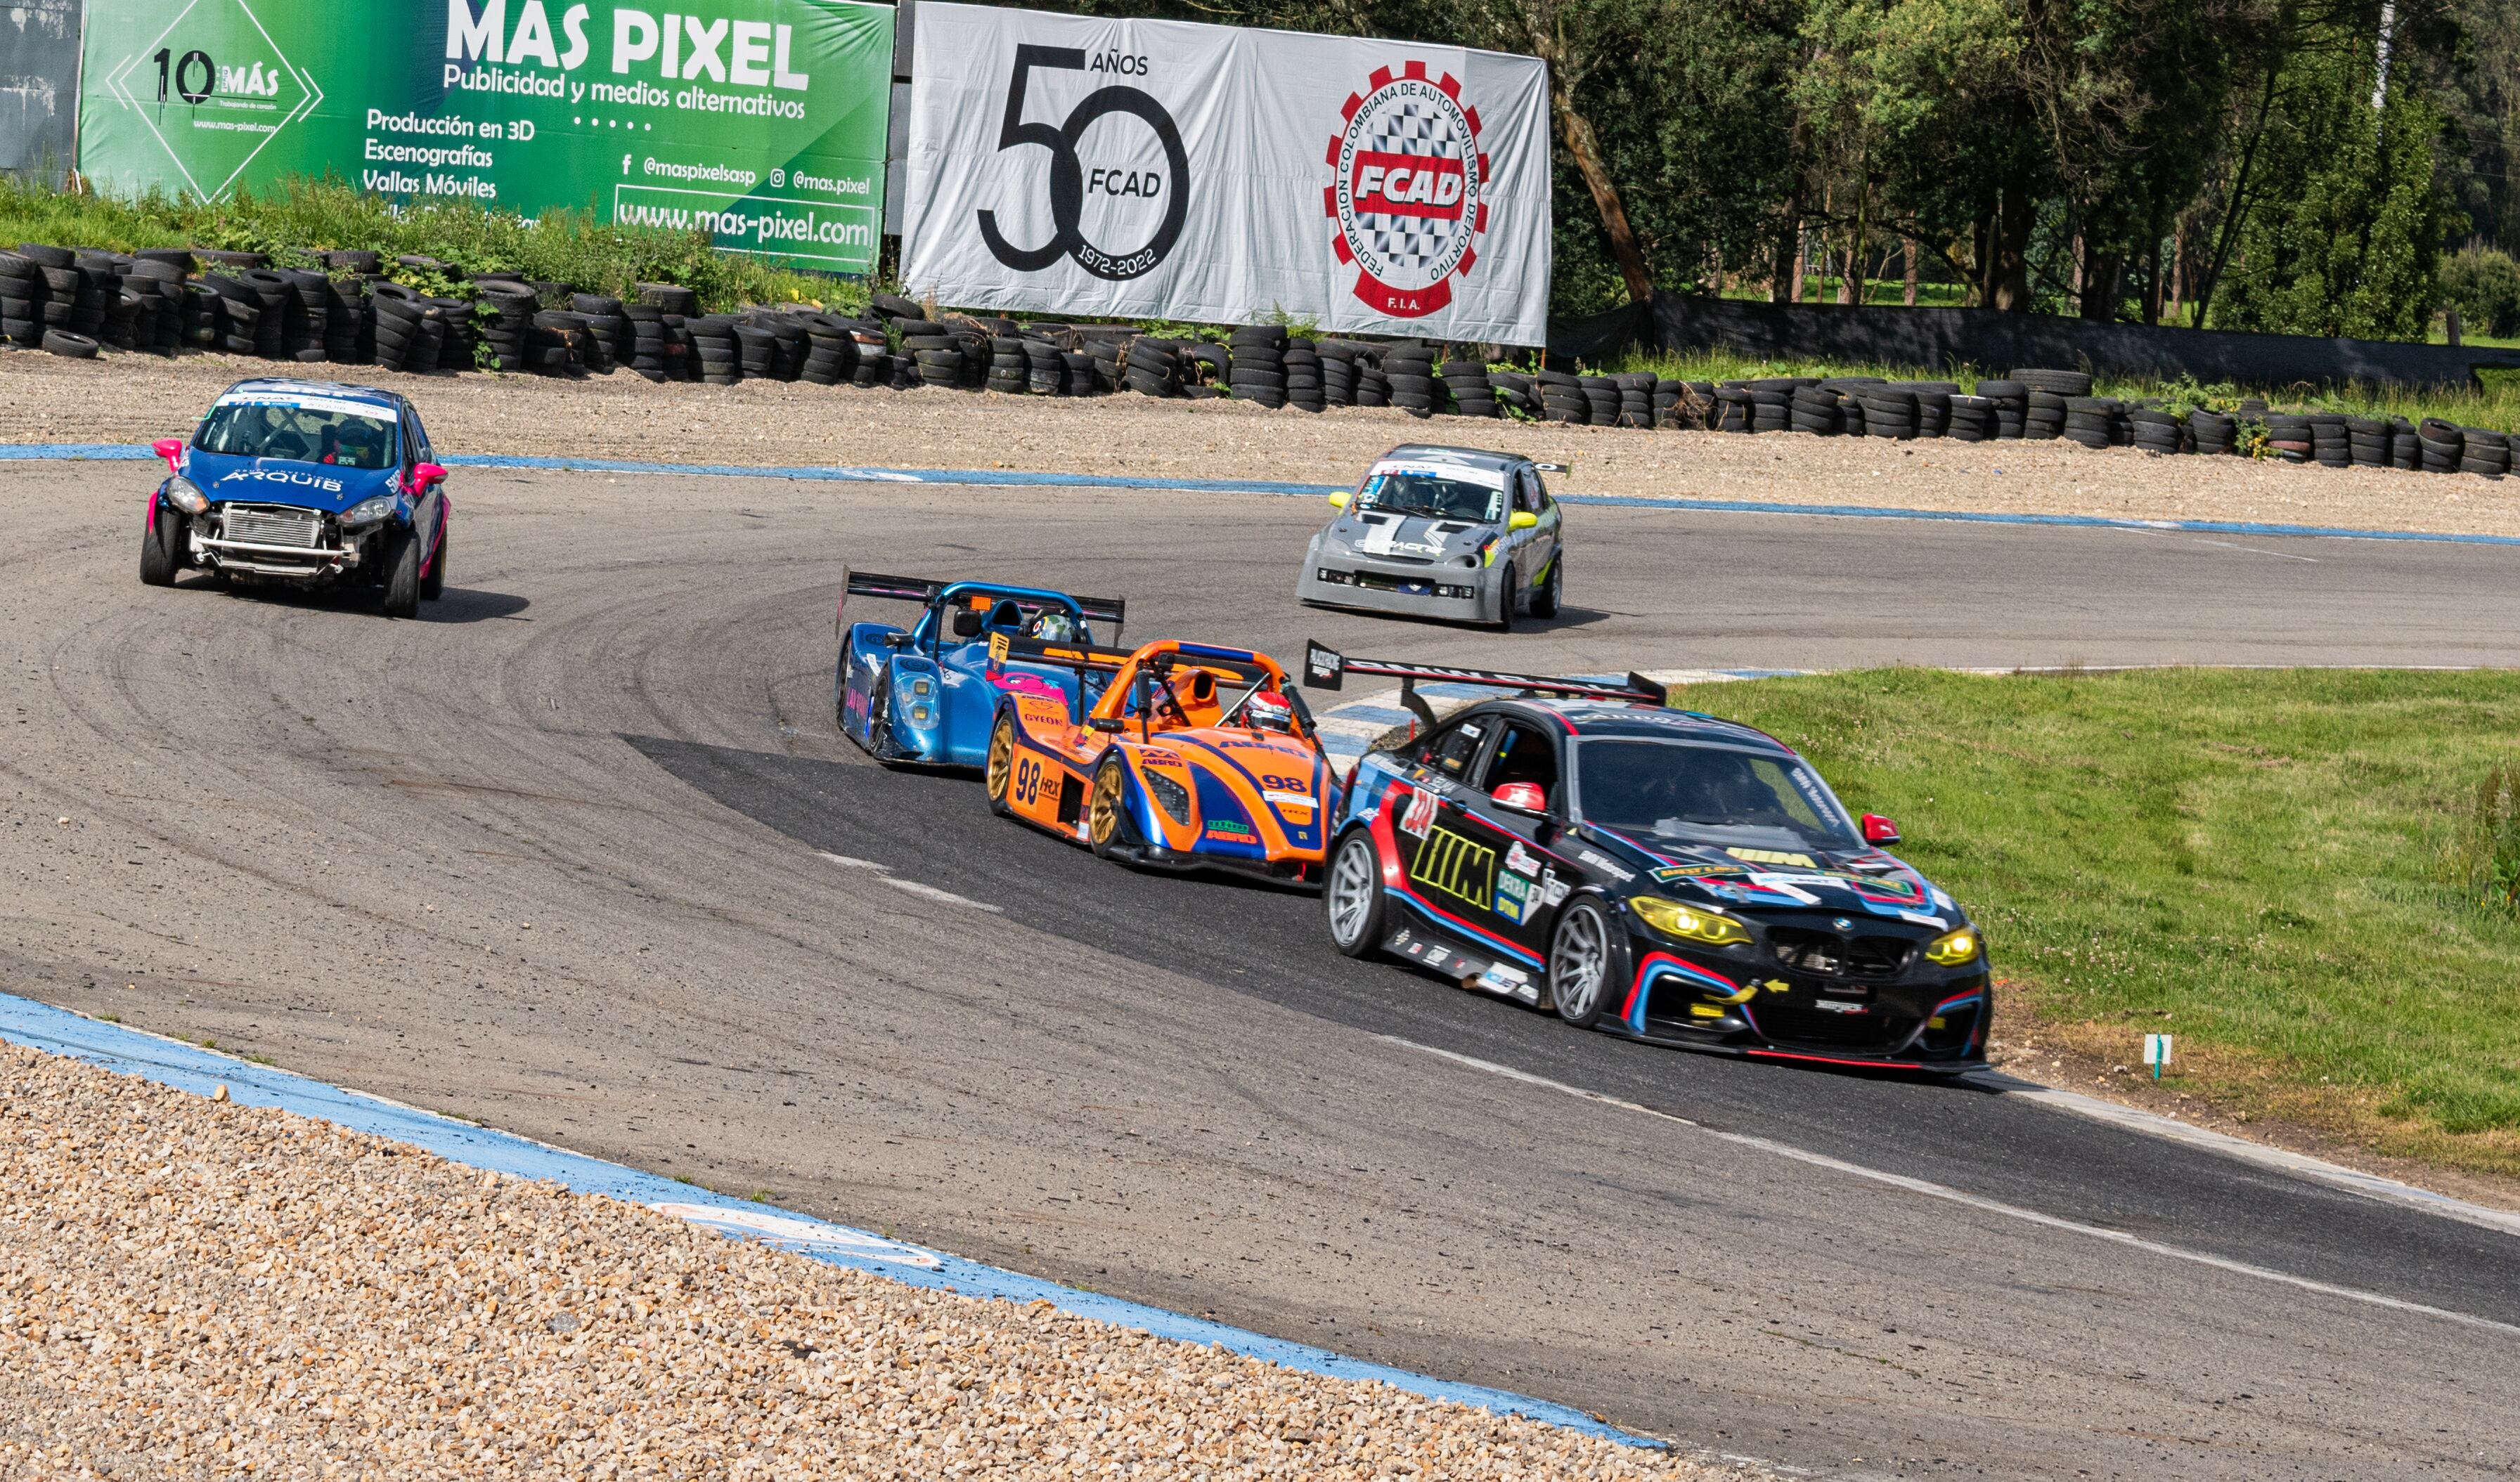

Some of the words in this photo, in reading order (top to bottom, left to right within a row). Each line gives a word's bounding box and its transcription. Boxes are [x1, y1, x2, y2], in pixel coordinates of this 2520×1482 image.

[612, 8, 809, 91] PIXEL
[1090, 48, 1149, 77] AÑOS
[154, 48, 215, 105] 10
[221, 61, 279, 96] MÁS
[444, 63, 565, 97] Publicidad
[571, 82, 585, 103] y
[591, 81, 670, 107] medios
[676, 86, 805, 119] alternativos
[1401, 83, 1417, 96] DE
[193, 120, 277, 134] www.mas-pixel.com
[367, 108, 474, 137] Producción
[479, 122, 503, 139] en
[508, 119, 535, 141] 3D
[1340, 86, 1398, 174] COLOMBIANA
[365, 138, 493, 168] Escenografías
[1419, 84, 1478, 197] AUTOMOVILISMO
[644, 157, 756, 188] @maspixelsasp
[976, 43, 1190, 282] 50
[363, 169, 420, 194] Vallas
[425, 173, 497, 199] Móviles
[793, 171, 870, 195] @mas.pixel
[1088, 168, 1161, 198] FCAD
[1355, 165, 1463, 208] FCAD
[619, 203, 869, 246] www.mas-pixel.com
[1341, 179, 1384, 278] FEDERACION
[1430, 202, 1477, 281] DEPORTIVO
[1078, 245, 1156, 275] 1972-2022
[220, 472, 342, 492] ARQUIB
[1025, 713, 1063, 727] GYEON
[1016, 758, 1041, 805] 98
[1040, 776, 1060, 796] HRX
[1262, 774, 1307, 793] 98
[1206, 829, 1257, 844] ABRO
